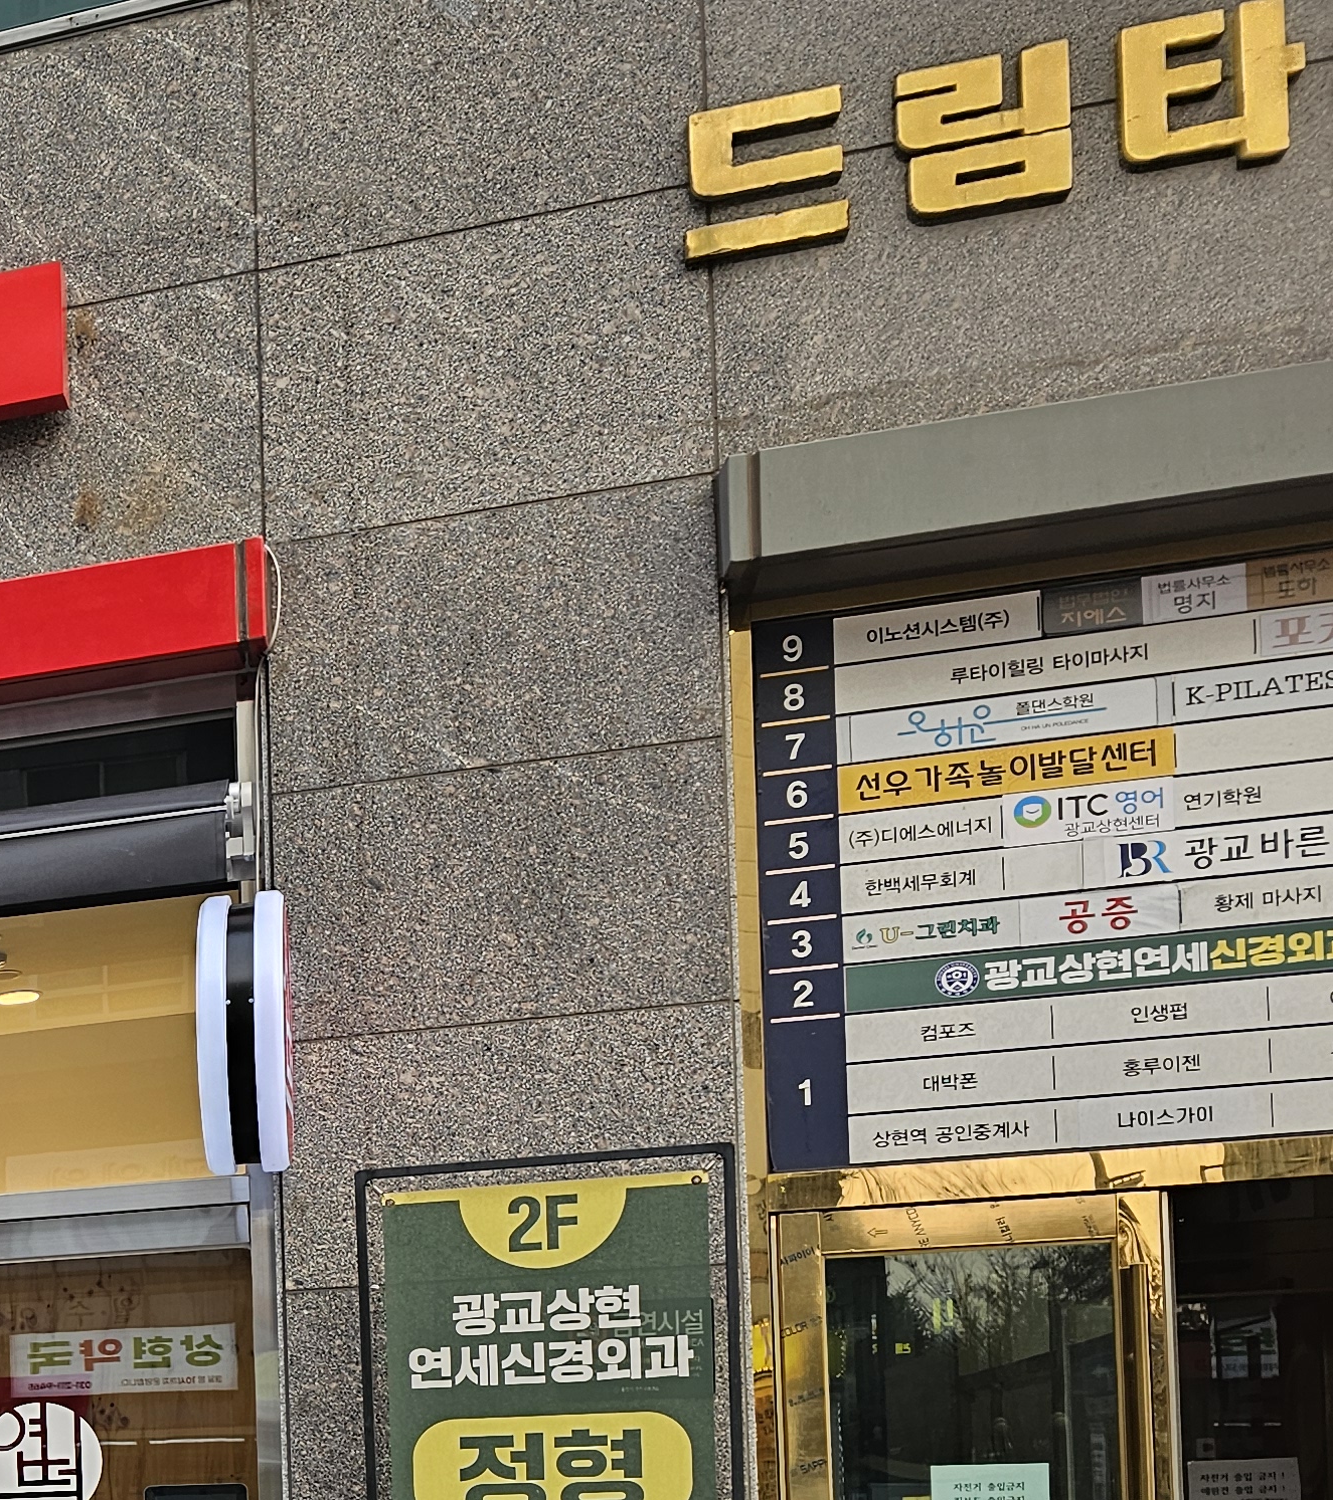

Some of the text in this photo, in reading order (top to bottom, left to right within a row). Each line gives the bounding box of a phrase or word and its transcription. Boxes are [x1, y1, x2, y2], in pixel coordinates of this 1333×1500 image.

[685, 0, 1305, 263] 드림타
[1173, 590, 1217, 615] 명지
[866, 609, 1010, 646] 이노션시스템(주)
[782, 635, 804, 663] 9
[949, 643, 1150, 685] 루타이힐링 타이마사지
[783, 684, 805, 711] 8
[784, 733, 805, 761] 7
[855, 739, 1157, 800] 선우가족놀이발달센터
[786, 781, 808, 810] 6
[1057, 787, 1165, 821] ITC 영어
[1184, 786, 1262, 811] 연기학원
[848, 816, 993, 850] (주)디에스에너지
[1064, 815, 1161, 836] 광교상현센터
[788, 832, 809, 860] 5
[789, 880, 811, 908] 4
[865, 868, 977, 896] 한백세무회계
[1213, 885, 1322, 912] 황제 마사지
[1058, 895, 1138, 936] 공증
[791, 930, 813, 958] 3
[983, 931, 1333, 991] 광교상현연세신경외
[792, 980, 814, 1008] 2
[1130, 1002, 1189, 1024] 인생펍
[921, 1022, 976, 1042] 컴포즈
[1122, 1053, 1201, 1077] 홍루이젠
[798, 1079, 812, 1106] 1
[923, 1072, 978, 1092] 대박폰
[1117, 1104, 1214, 1131] 나이스가이
[873, 1120, 1029, 1148] 상현역 공인중계사
[508, 1193, 579, 1253] 2F
[451, 1284, 641, 1337] 광교상현
[408, 1334, 694, 1390] 연세신경외과
